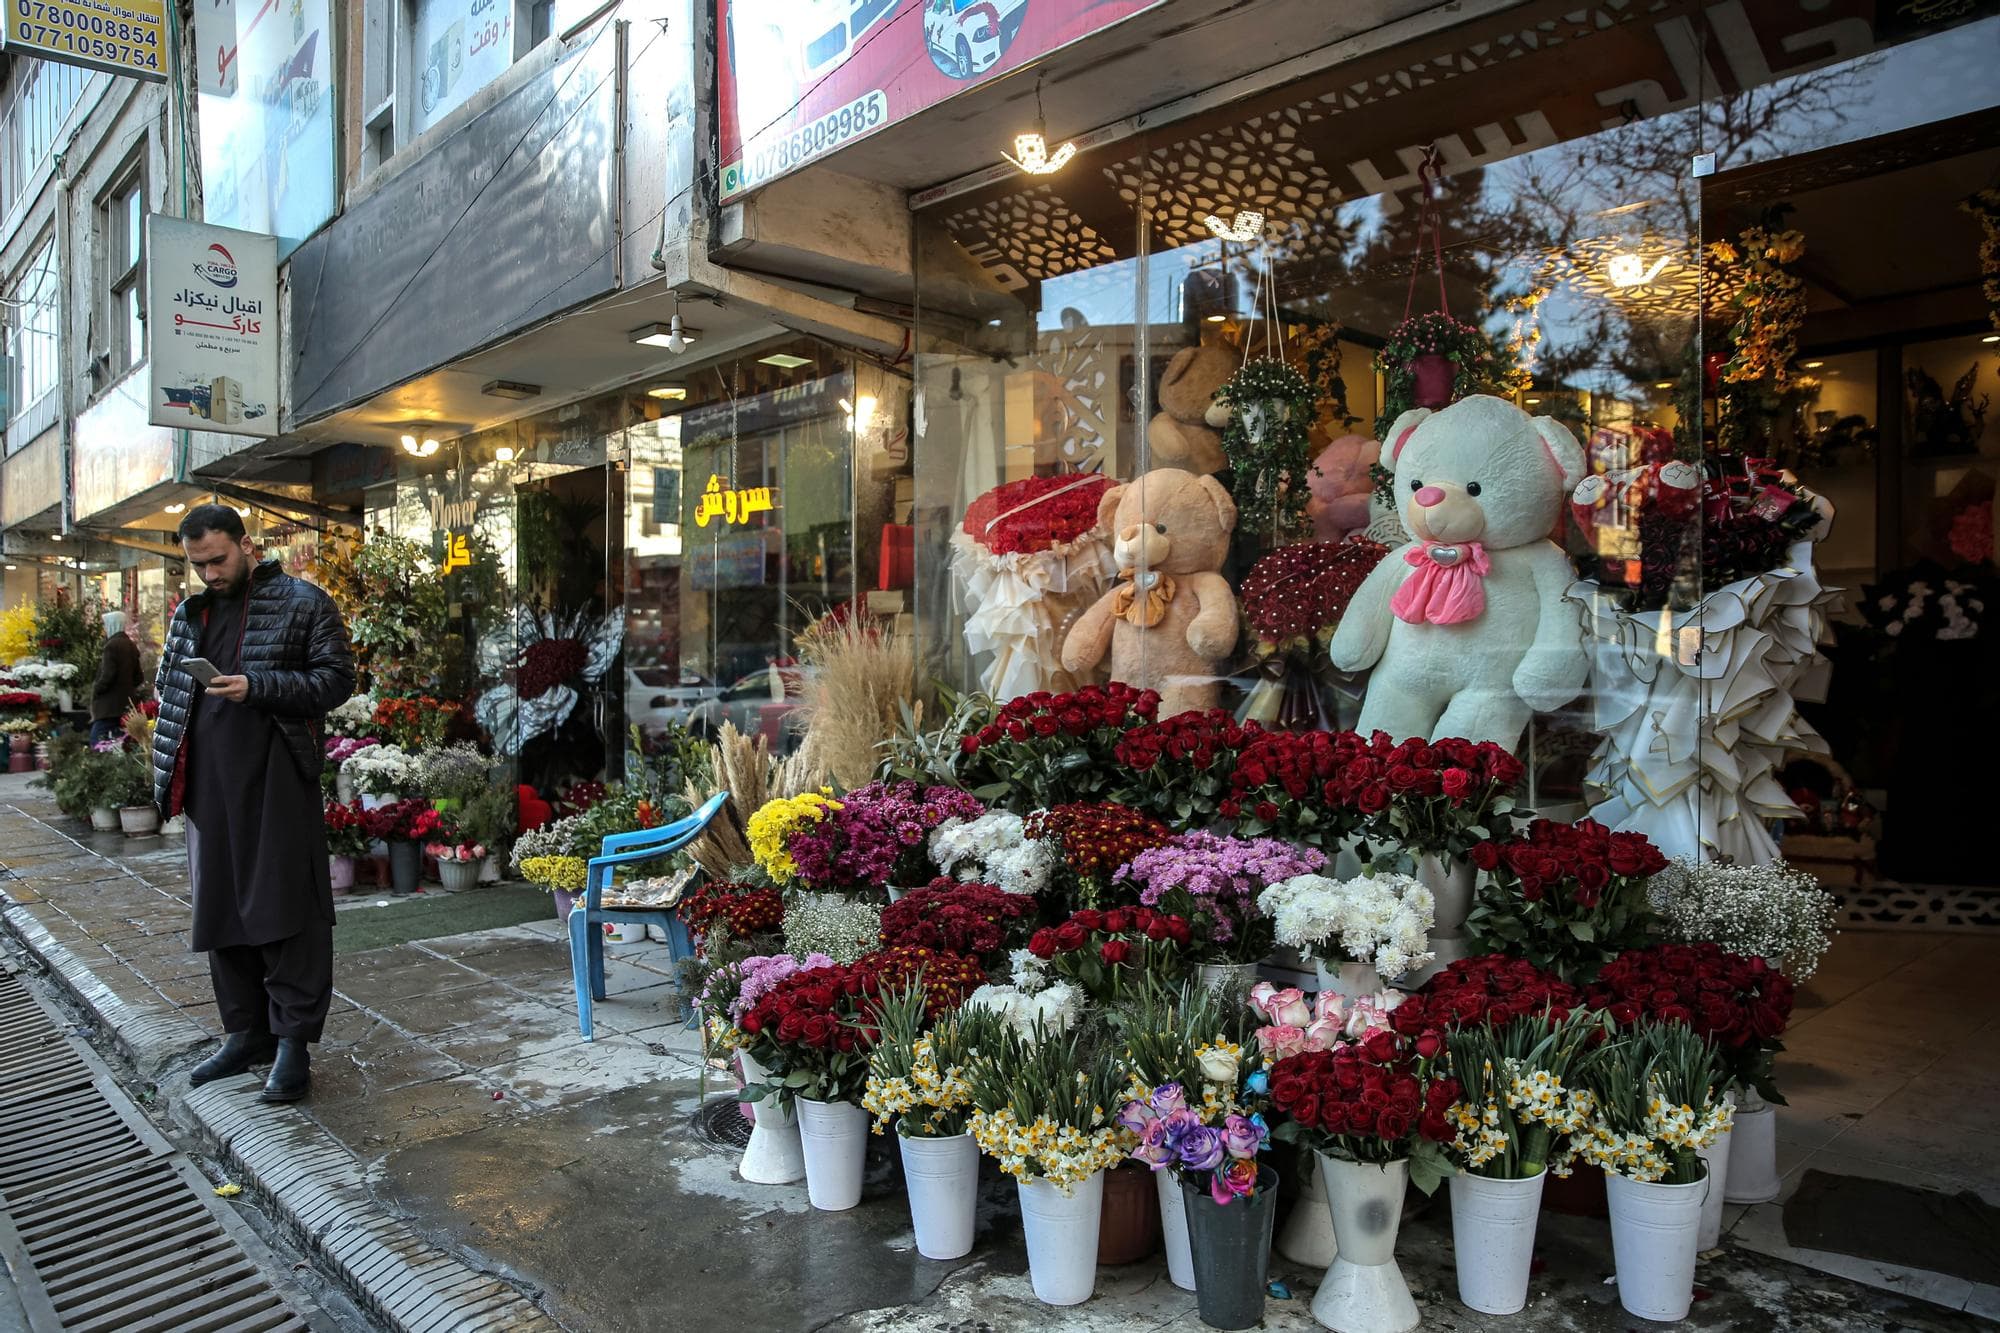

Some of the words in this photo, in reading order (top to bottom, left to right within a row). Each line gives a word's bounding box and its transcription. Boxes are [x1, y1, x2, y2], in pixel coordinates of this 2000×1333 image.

[17, 0, 158, 47] 0780008854
[469, 20, 499, 56] وقت
[19, 22, 159, 69] 0771059754
[755, 93, 881, 180] 0786809985
[207, 265, 238, 276] CARGO
[174, 289, 218, 312] نیکزاد
[223, 296, 262, 316] اقبال
[174, 312, 261, 335] کارگو
[430, 494, 478, 531] Flower
[694, 472, 774, 528] سروش
[443, 531, 471, 575] گل
